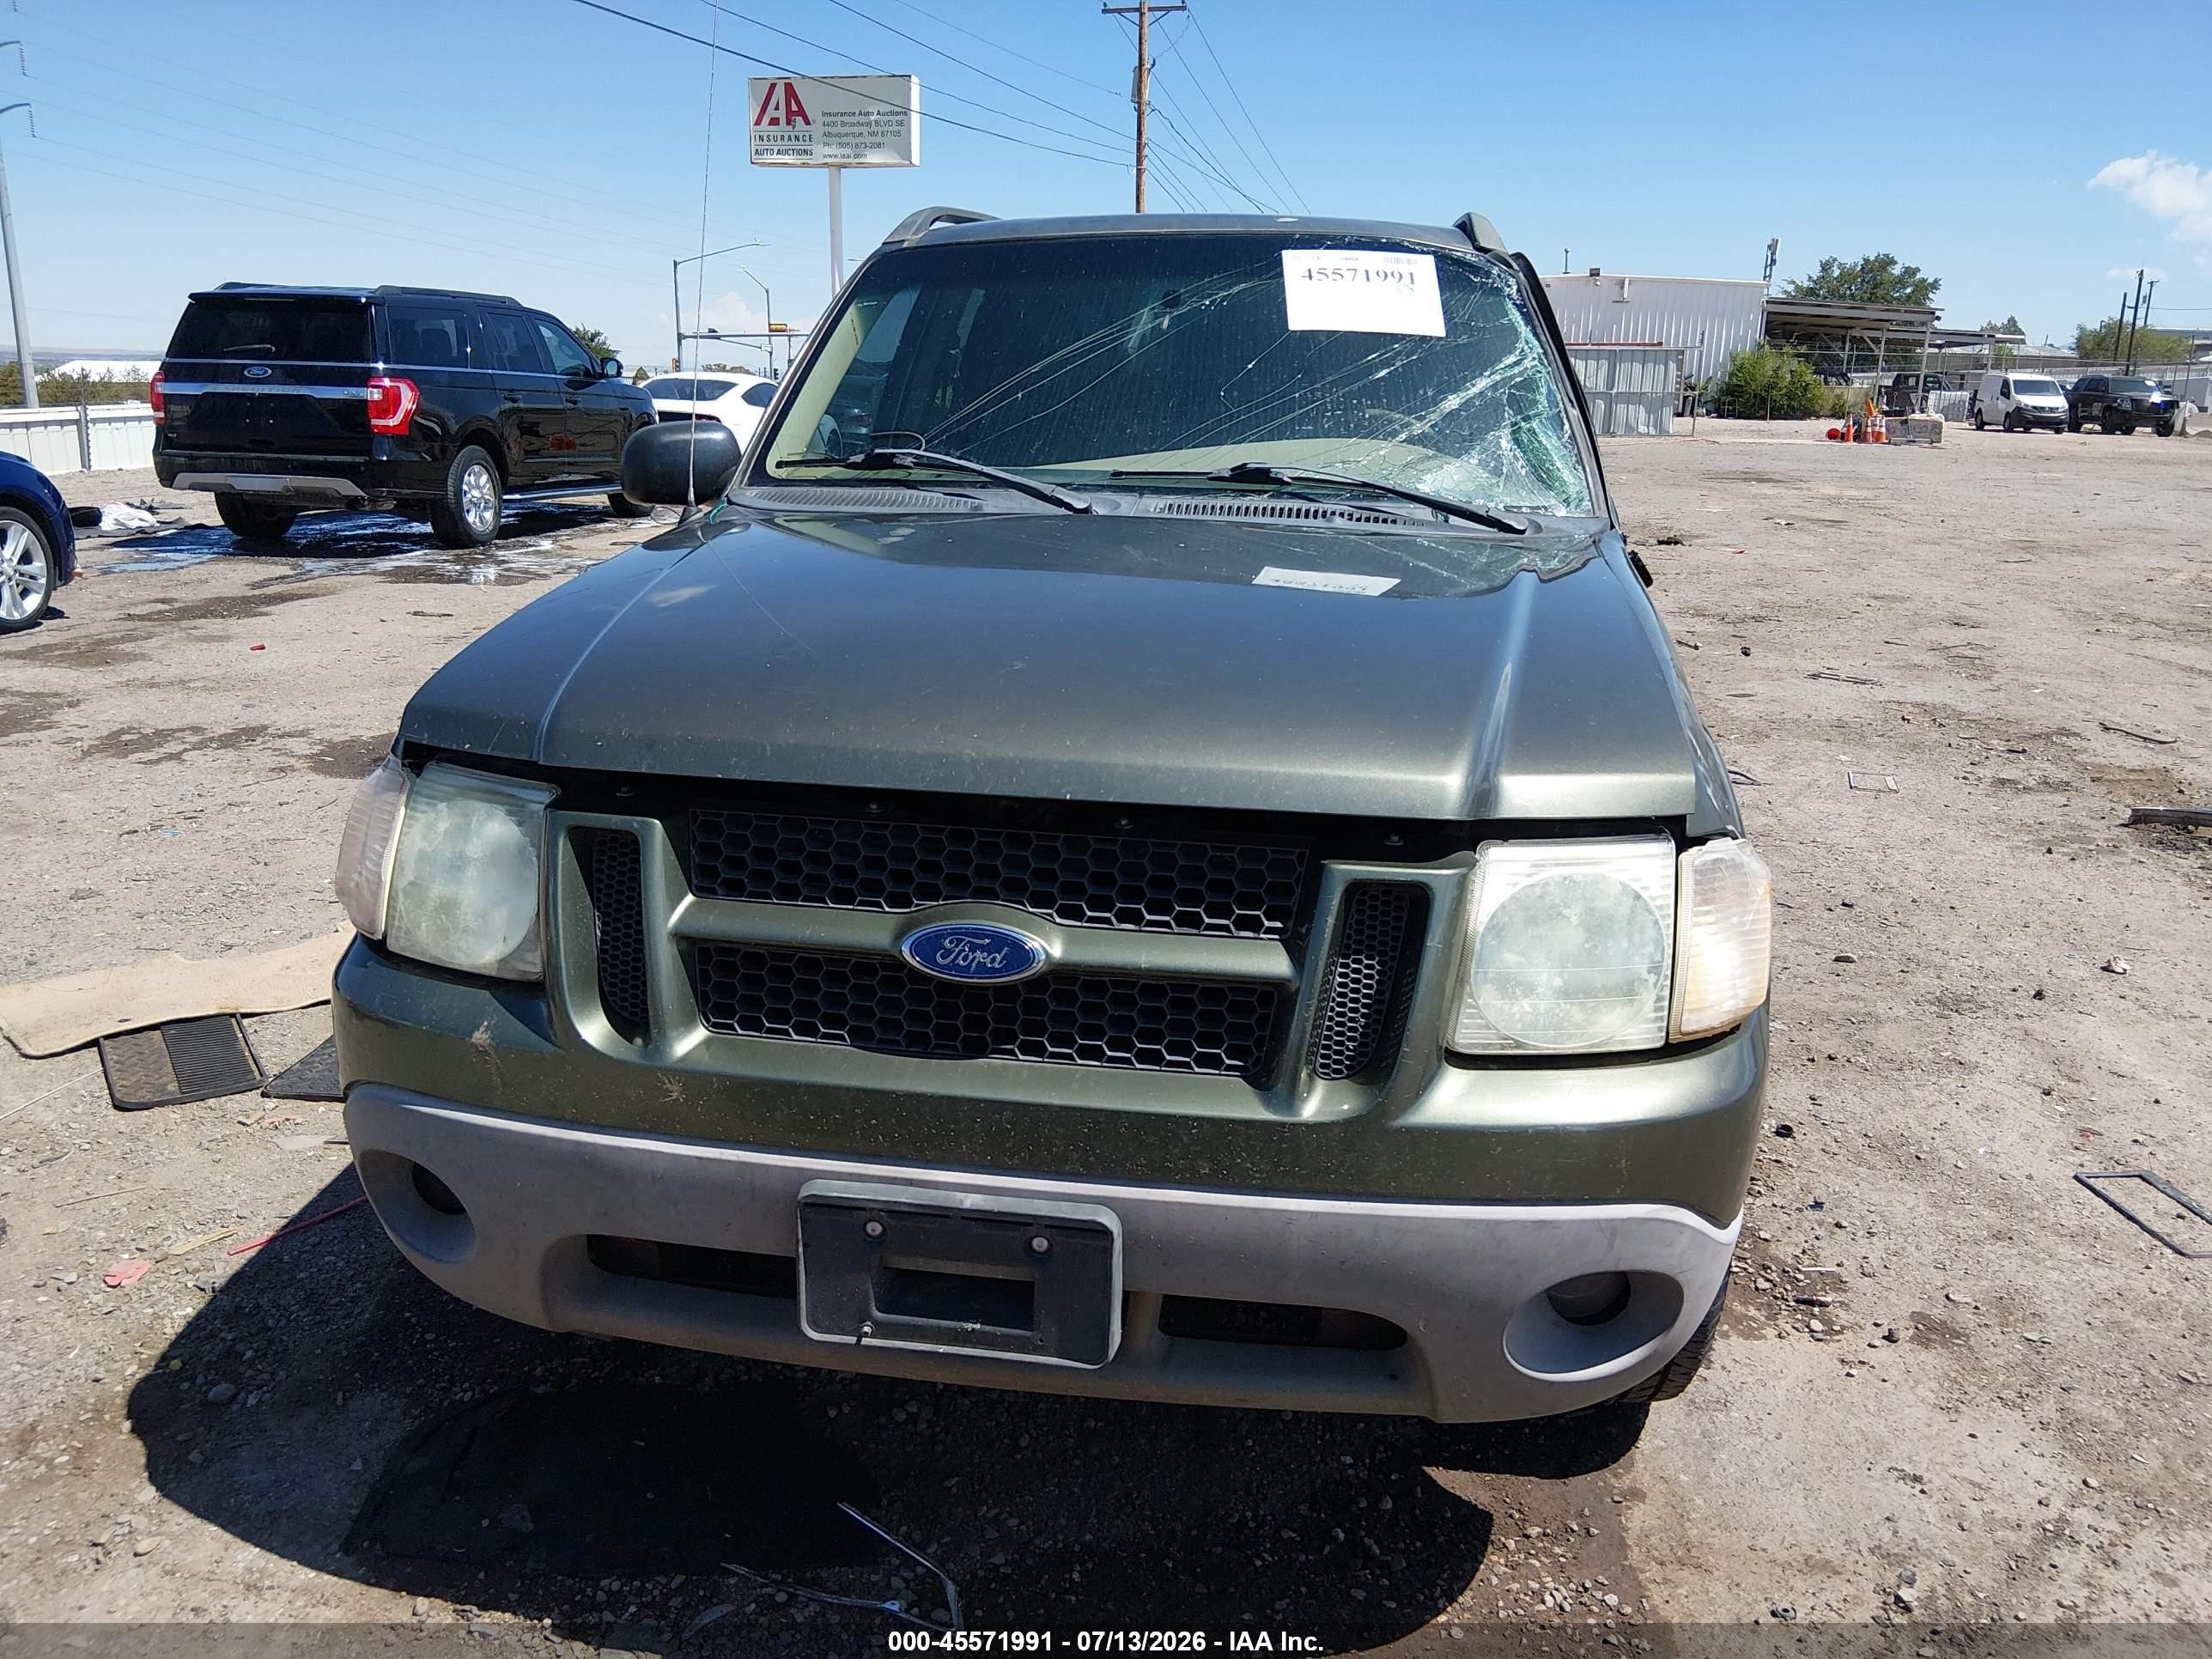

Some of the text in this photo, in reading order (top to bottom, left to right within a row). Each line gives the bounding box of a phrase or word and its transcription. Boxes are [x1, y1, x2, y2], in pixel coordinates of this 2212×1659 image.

[840, 120, 872, 129] Broadway
[754, 134, 814, 143] INSURANCE
[755, 148, 814, 156] AUTO AUCTIONS
[1301, 267, 1415, 285] 45571991
[936, 935, 1010, 974] Ford
